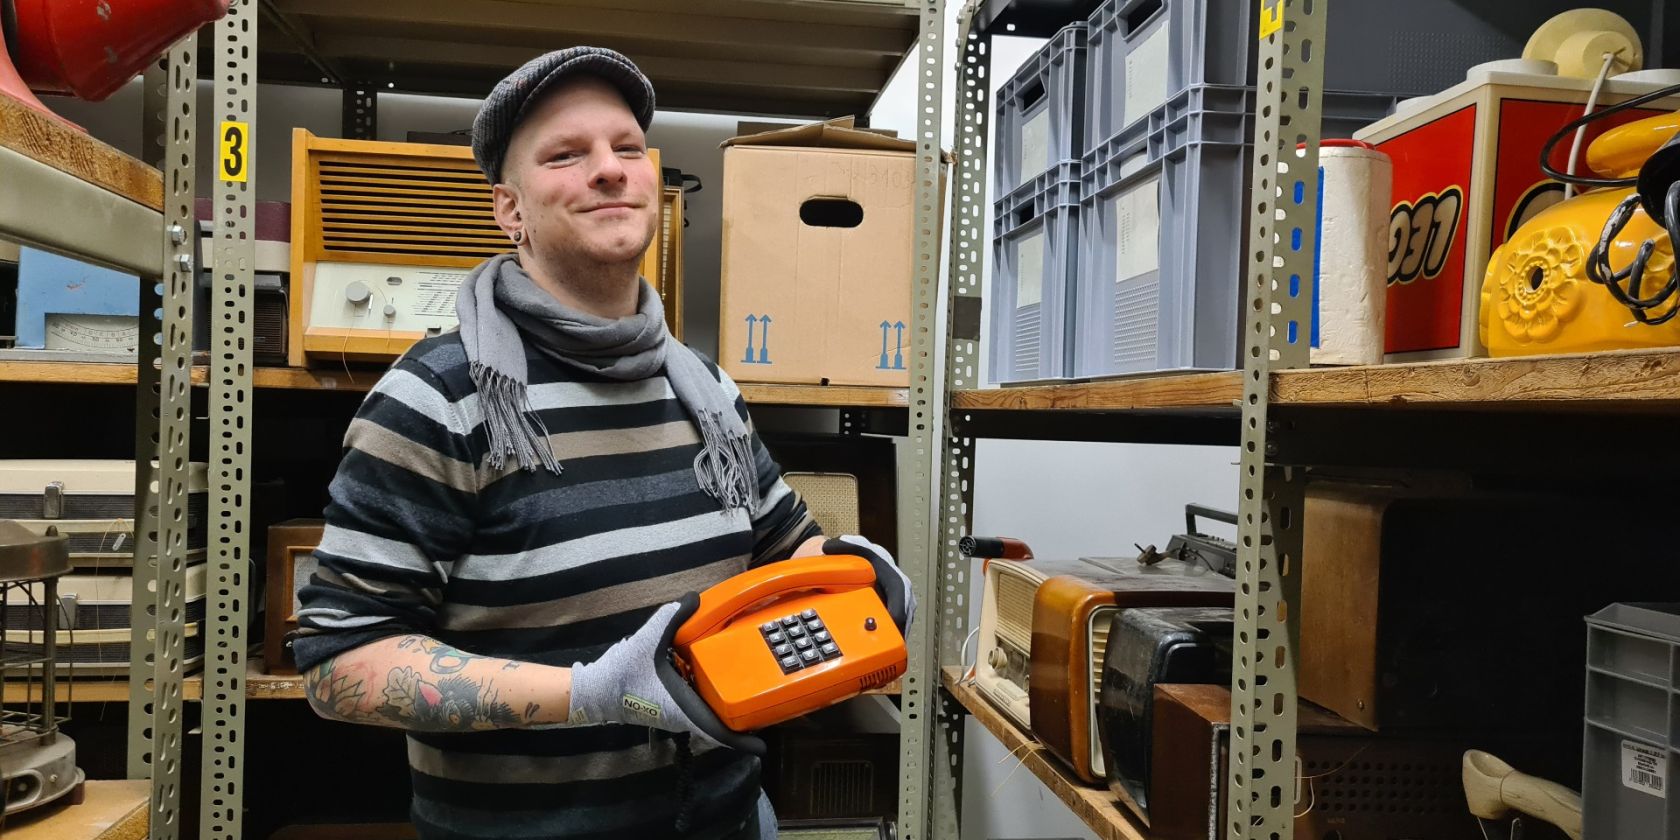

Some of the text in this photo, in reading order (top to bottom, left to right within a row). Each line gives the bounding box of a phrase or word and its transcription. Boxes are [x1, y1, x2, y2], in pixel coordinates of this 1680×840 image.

[224, 127, 242, 176] 3
[1387, 186, 1463, 286] LEG
[624, 698, 658, 717] NO-XO
